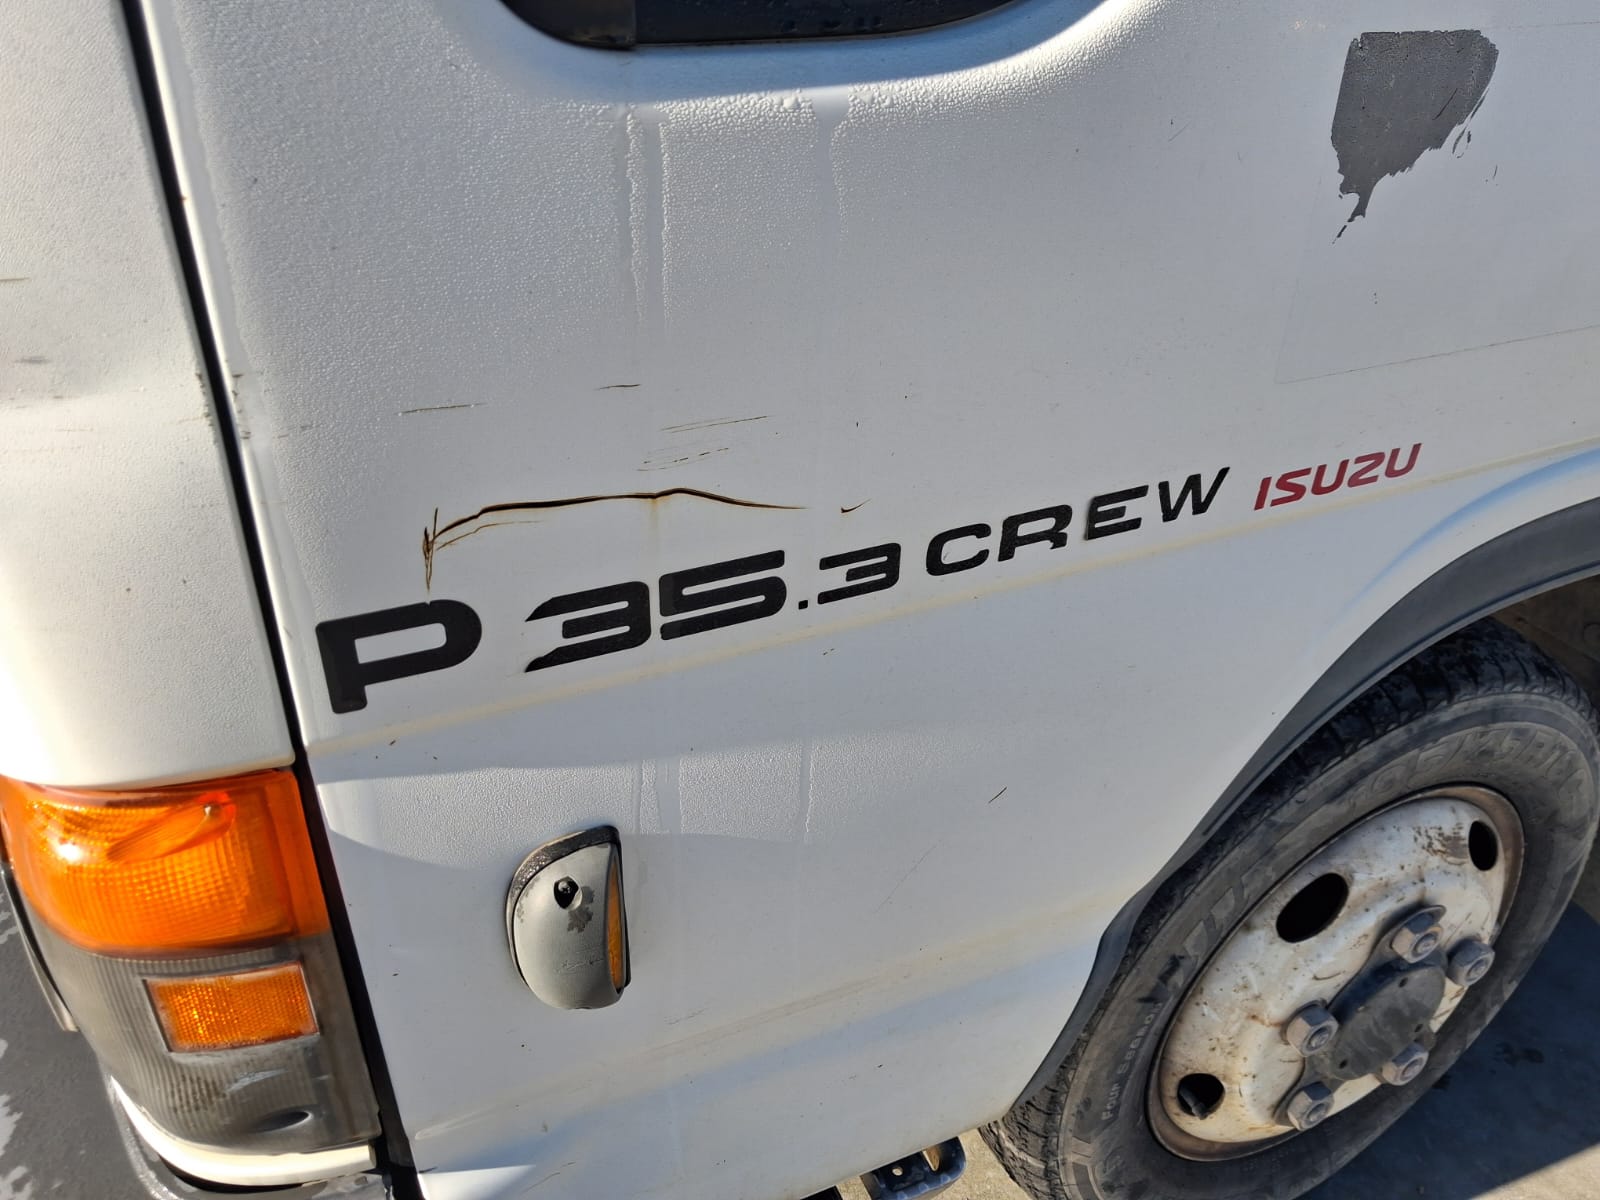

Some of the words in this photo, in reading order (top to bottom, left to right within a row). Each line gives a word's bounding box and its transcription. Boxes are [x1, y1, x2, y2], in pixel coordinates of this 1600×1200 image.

[1253, 443, 1422, 510] ISUZU
[315, 600, 482, 714] P
[524, 543, 901, 673] 35.3
[926, 467, 1230, 576] CREW
